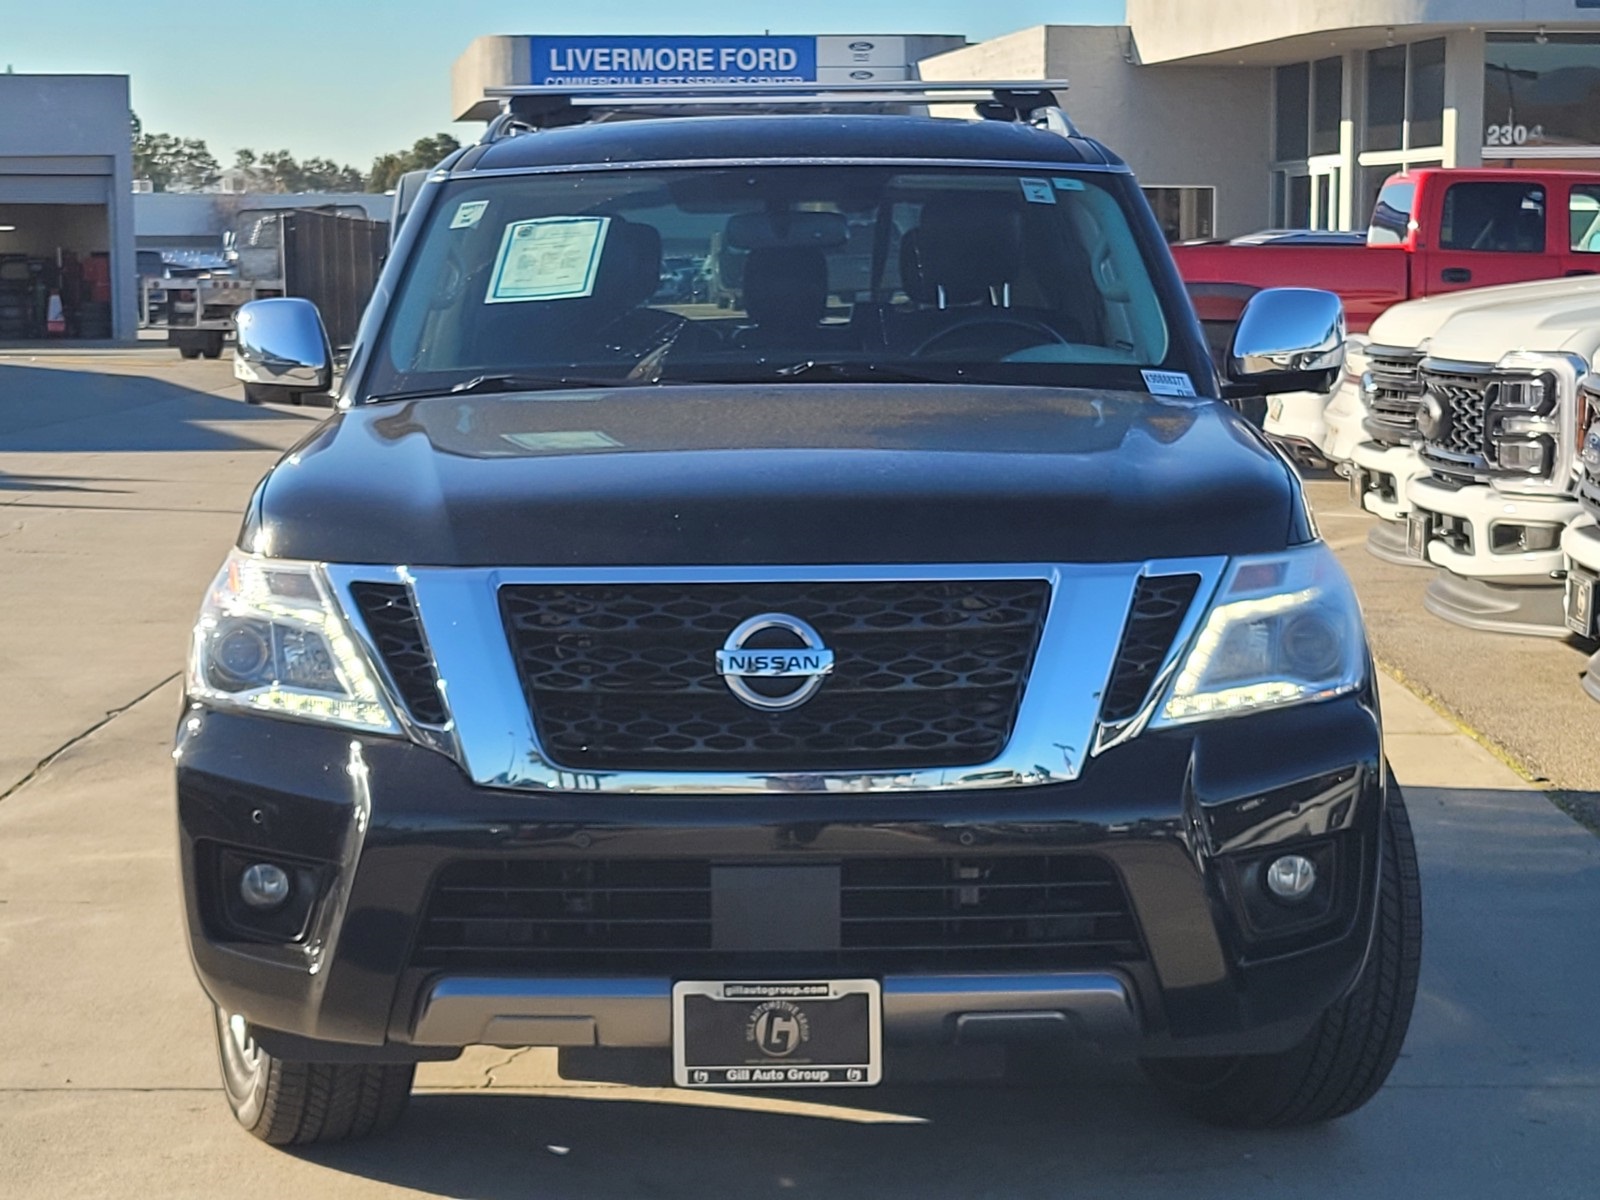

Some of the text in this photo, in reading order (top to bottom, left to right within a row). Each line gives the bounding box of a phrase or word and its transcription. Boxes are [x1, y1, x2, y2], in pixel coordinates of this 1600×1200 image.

[550, 47, 798, 71] LIVERMORE FORD
[544, 77, 637, 85] COMMERCIAL
[729, 655, 819, 670] NISSAN
[725, 985, 828, 996] gillautogroup.com
[726, 1069, 750, 1081] Gill
[752, 1069, 784, 1081] Auto
[787, 1068, 830, 1082] Group
